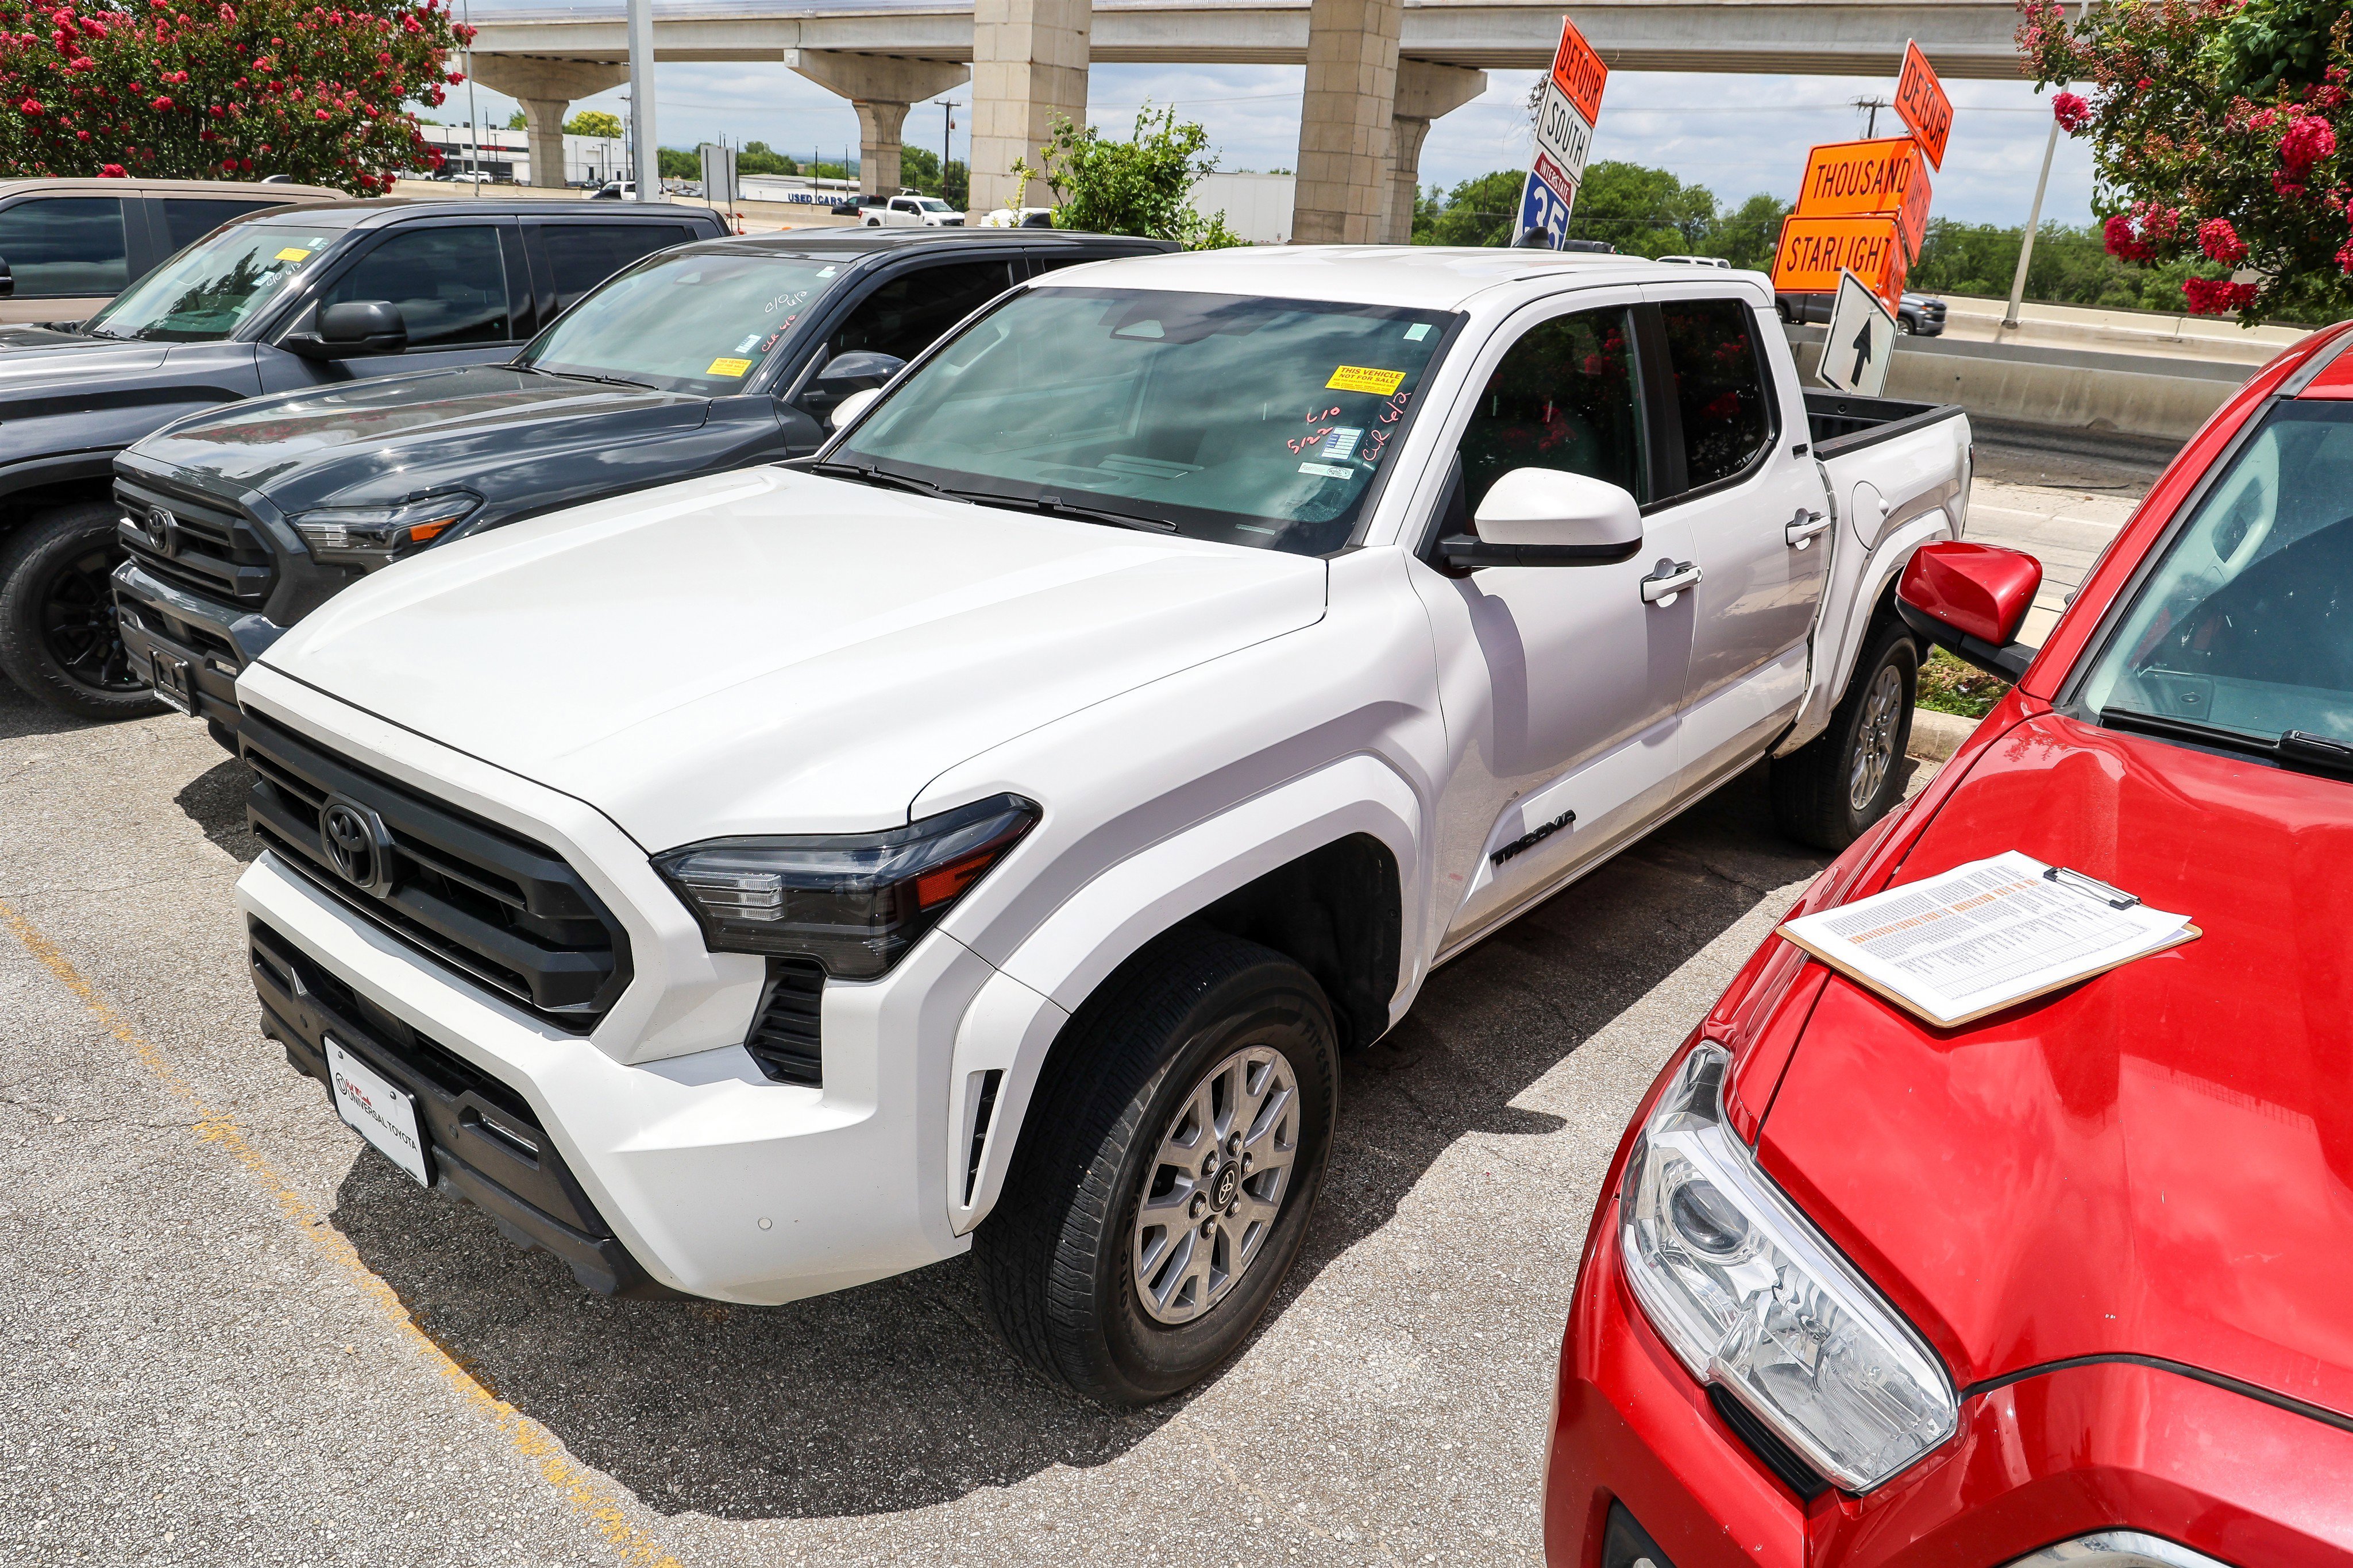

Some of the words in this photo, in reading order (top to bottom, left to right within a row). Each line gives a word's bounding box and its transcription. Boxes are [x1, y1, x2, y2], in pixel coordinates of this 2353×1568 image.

[1559, 36, 1601, 111] DETOUR
[1546, 101, 1587, 168] SOUTH
[1903, 61, 1947, 153] DETOUR
[788, 193, 812, 203] USED
[817, 195, 843, 205] CARS
[1540, 159, 1570, 202] INTERSTATE
[1813, 157, 1911, 199] THOUSAND
[1533, 186, 1565, 251] 35
[1787, 235, 1891, 274] STARLIGHT
[1363, 370, 1402, 379] VEHICLE
[1490, 809, 1577, 866] TACOMA
[1299, 1017, 1332, 1140] Firestone
[347, 1089, 388, 1129] UNIVERSAL
[387, 1121, 418, 1152] TOYOTA
